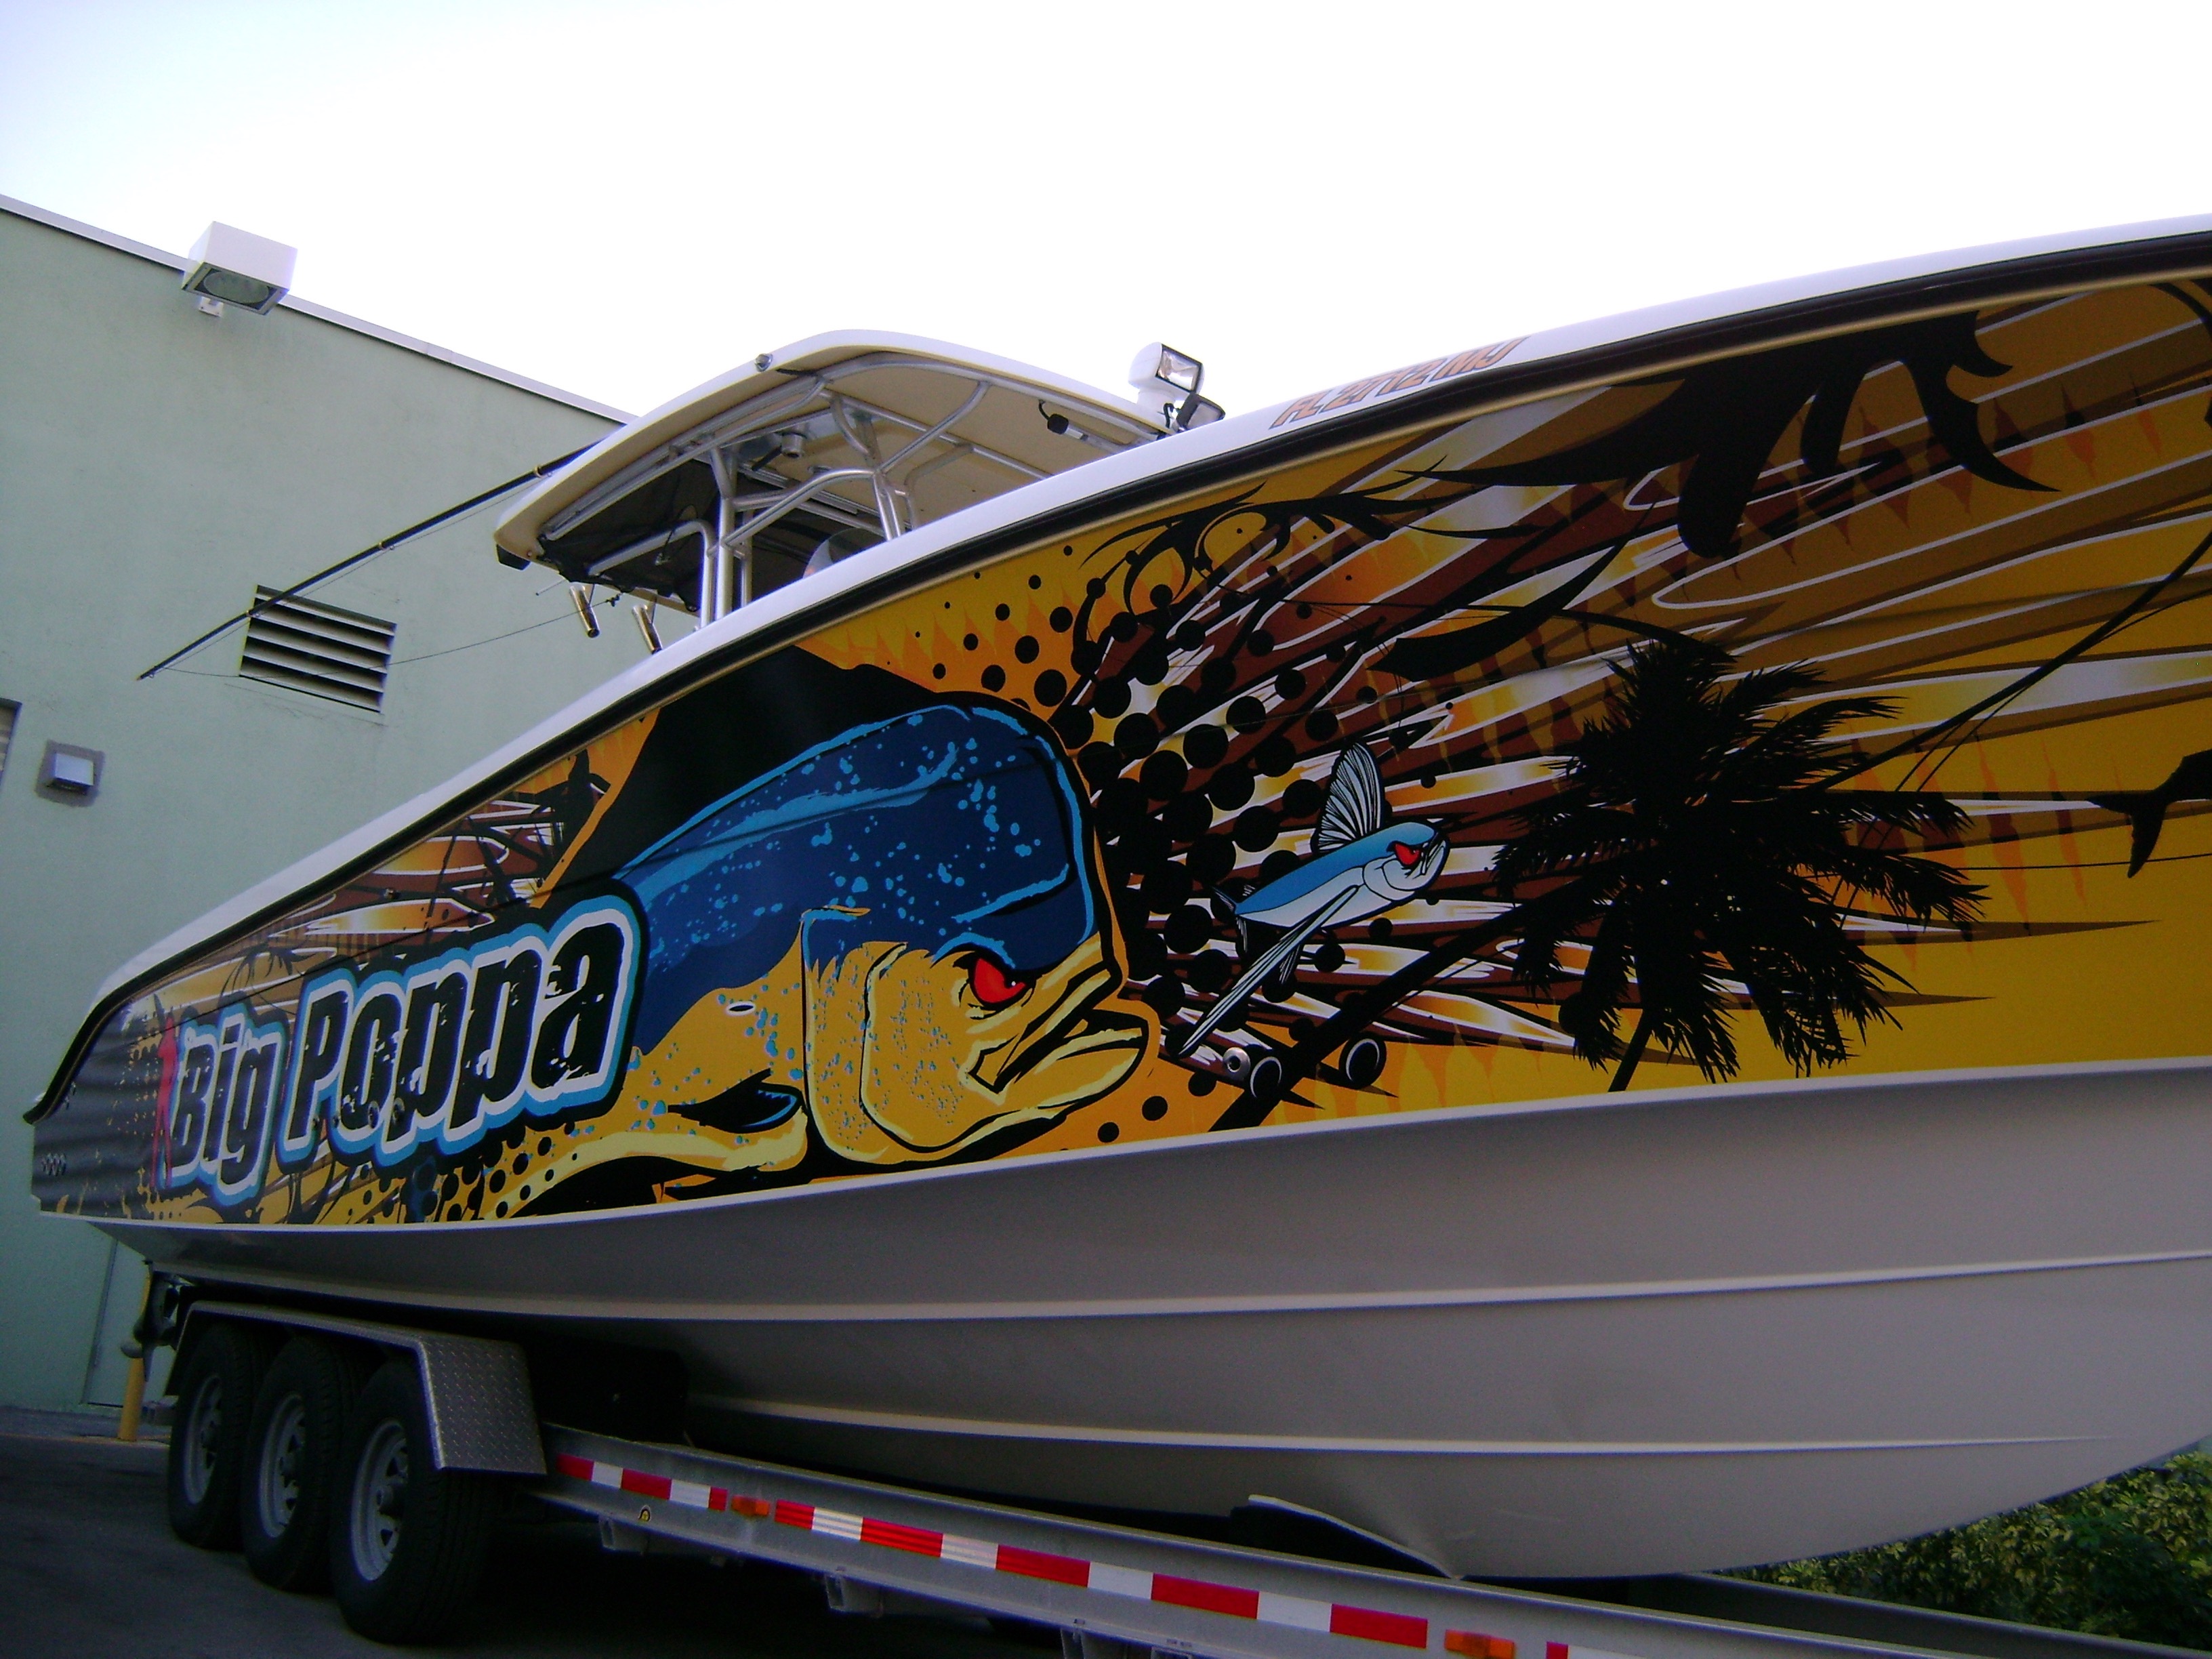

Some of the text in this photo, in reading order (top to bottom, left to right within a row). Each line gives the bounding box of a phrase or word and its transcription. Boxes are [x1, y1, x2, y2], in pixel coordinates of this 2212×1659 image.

[1268, 388, 1334, 430] FL
[1428, 335, 1531, 382] MJ
[167, 909, 636, 1194] Big Poppa
